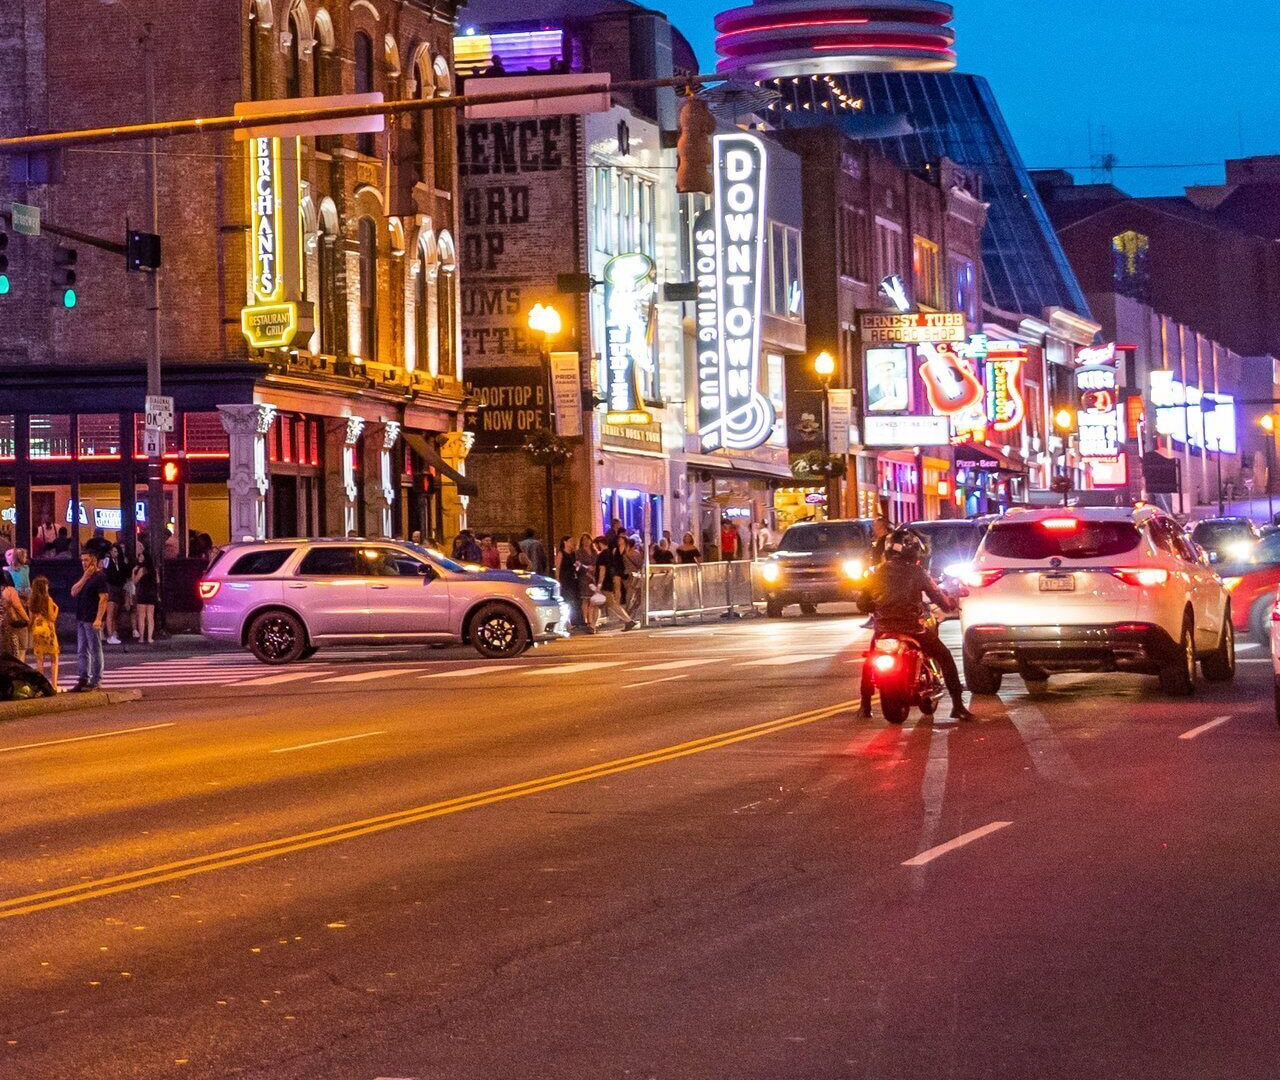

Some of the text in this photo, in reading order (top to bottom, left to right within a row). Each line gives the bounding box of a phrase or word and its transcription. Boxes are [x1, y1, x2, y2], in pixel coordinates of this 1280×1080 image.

[724, 150, 755, 398] DOWNTOWN
[249, 312, 290, 328] RESTAURANT
[696, 229, 720, 410] SPORTING CLUB
[864, 313, 963, 327] ERNEST TUBB
[266, 324, 284, 336] GRILL
[871, 328, 956, 341] RECORD SHOP
[147, 413, 158, 426] OK
[483, 410, 513, 431] NOW
[956, 460, 998, 468] Pizza Beer
